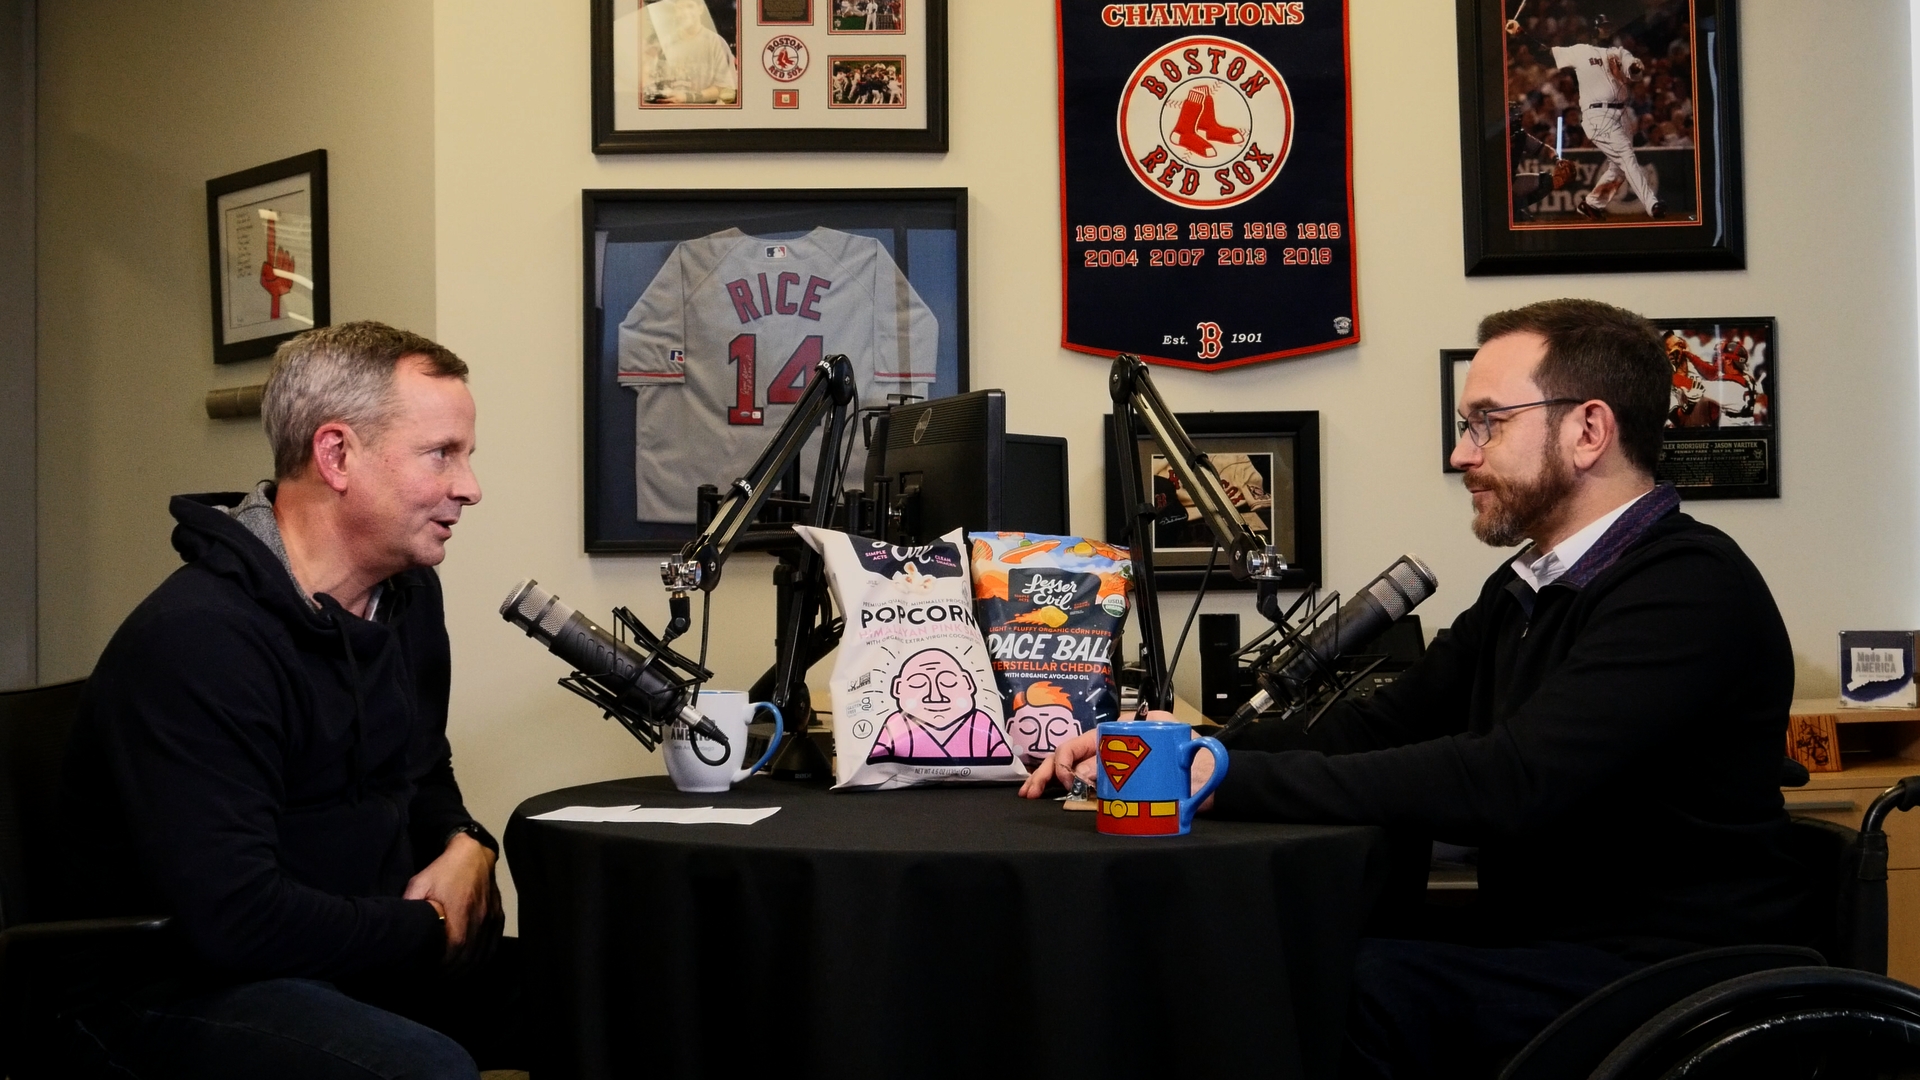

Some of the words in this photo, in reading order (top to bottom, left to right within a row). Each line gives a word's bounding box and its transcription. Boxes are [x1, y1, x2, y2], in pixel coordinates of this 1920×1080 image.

[1102, 2, 1304, 27] CHAMPIONS
[767, 38, 803, 52] BOSTON
[768, 65, 785, 79] RED
[787, 66, 803, 79] SOX
[1141, 48, 1270, 100] BOSTON
[1139, 145, 1201, 196] RED
[1213, 142, 1275, 196] SOX
[1075, 225, 1127, 241] 1903
[1134, 224, 1178, 241] 1912
[1189, 223, 1233, 240] 1915
[1243, 223, 1287, 239] 1916
[1297, 223, 1341, 239] 1918
[1084, 250, 1138, 267] 2004
[1150, 249, 1205, 266] 2007
[1218, 248, 1267, 266] 2013
[1283, 248, 1332, 265] 2018
[726, 271, 832, 325] RICE
[1162, 334, 1188, 346] Est.
[1196, 322, 1224, 360] B
[1231, 333, 1263, 344] 1901
[727, 333, 824, 426] 14
[1022, 573, 1077, 594] Lesser
[1033, 587, 1073, 610] Evil
[861, 604, 977, 629] POPCORN
[931, 623, 962, 632] PINK
[1091, 629, 1112, 637] PUFFS
[926, 633, 948, 642] VIRGIN
[988, 633, 1053, 660] PACE
[1052, 635, 1113, 663] BALL
[1857, 651, 1881, 662] Made
[1884, 651, 1894, 662] in
[992, 661, 1057, 672] TERSTELLAR
[1060, 662, 1111, 675] CHEDDAR
[1855, 662, 1896, 673] AMERICA
[858, 723, 866, 733] V
